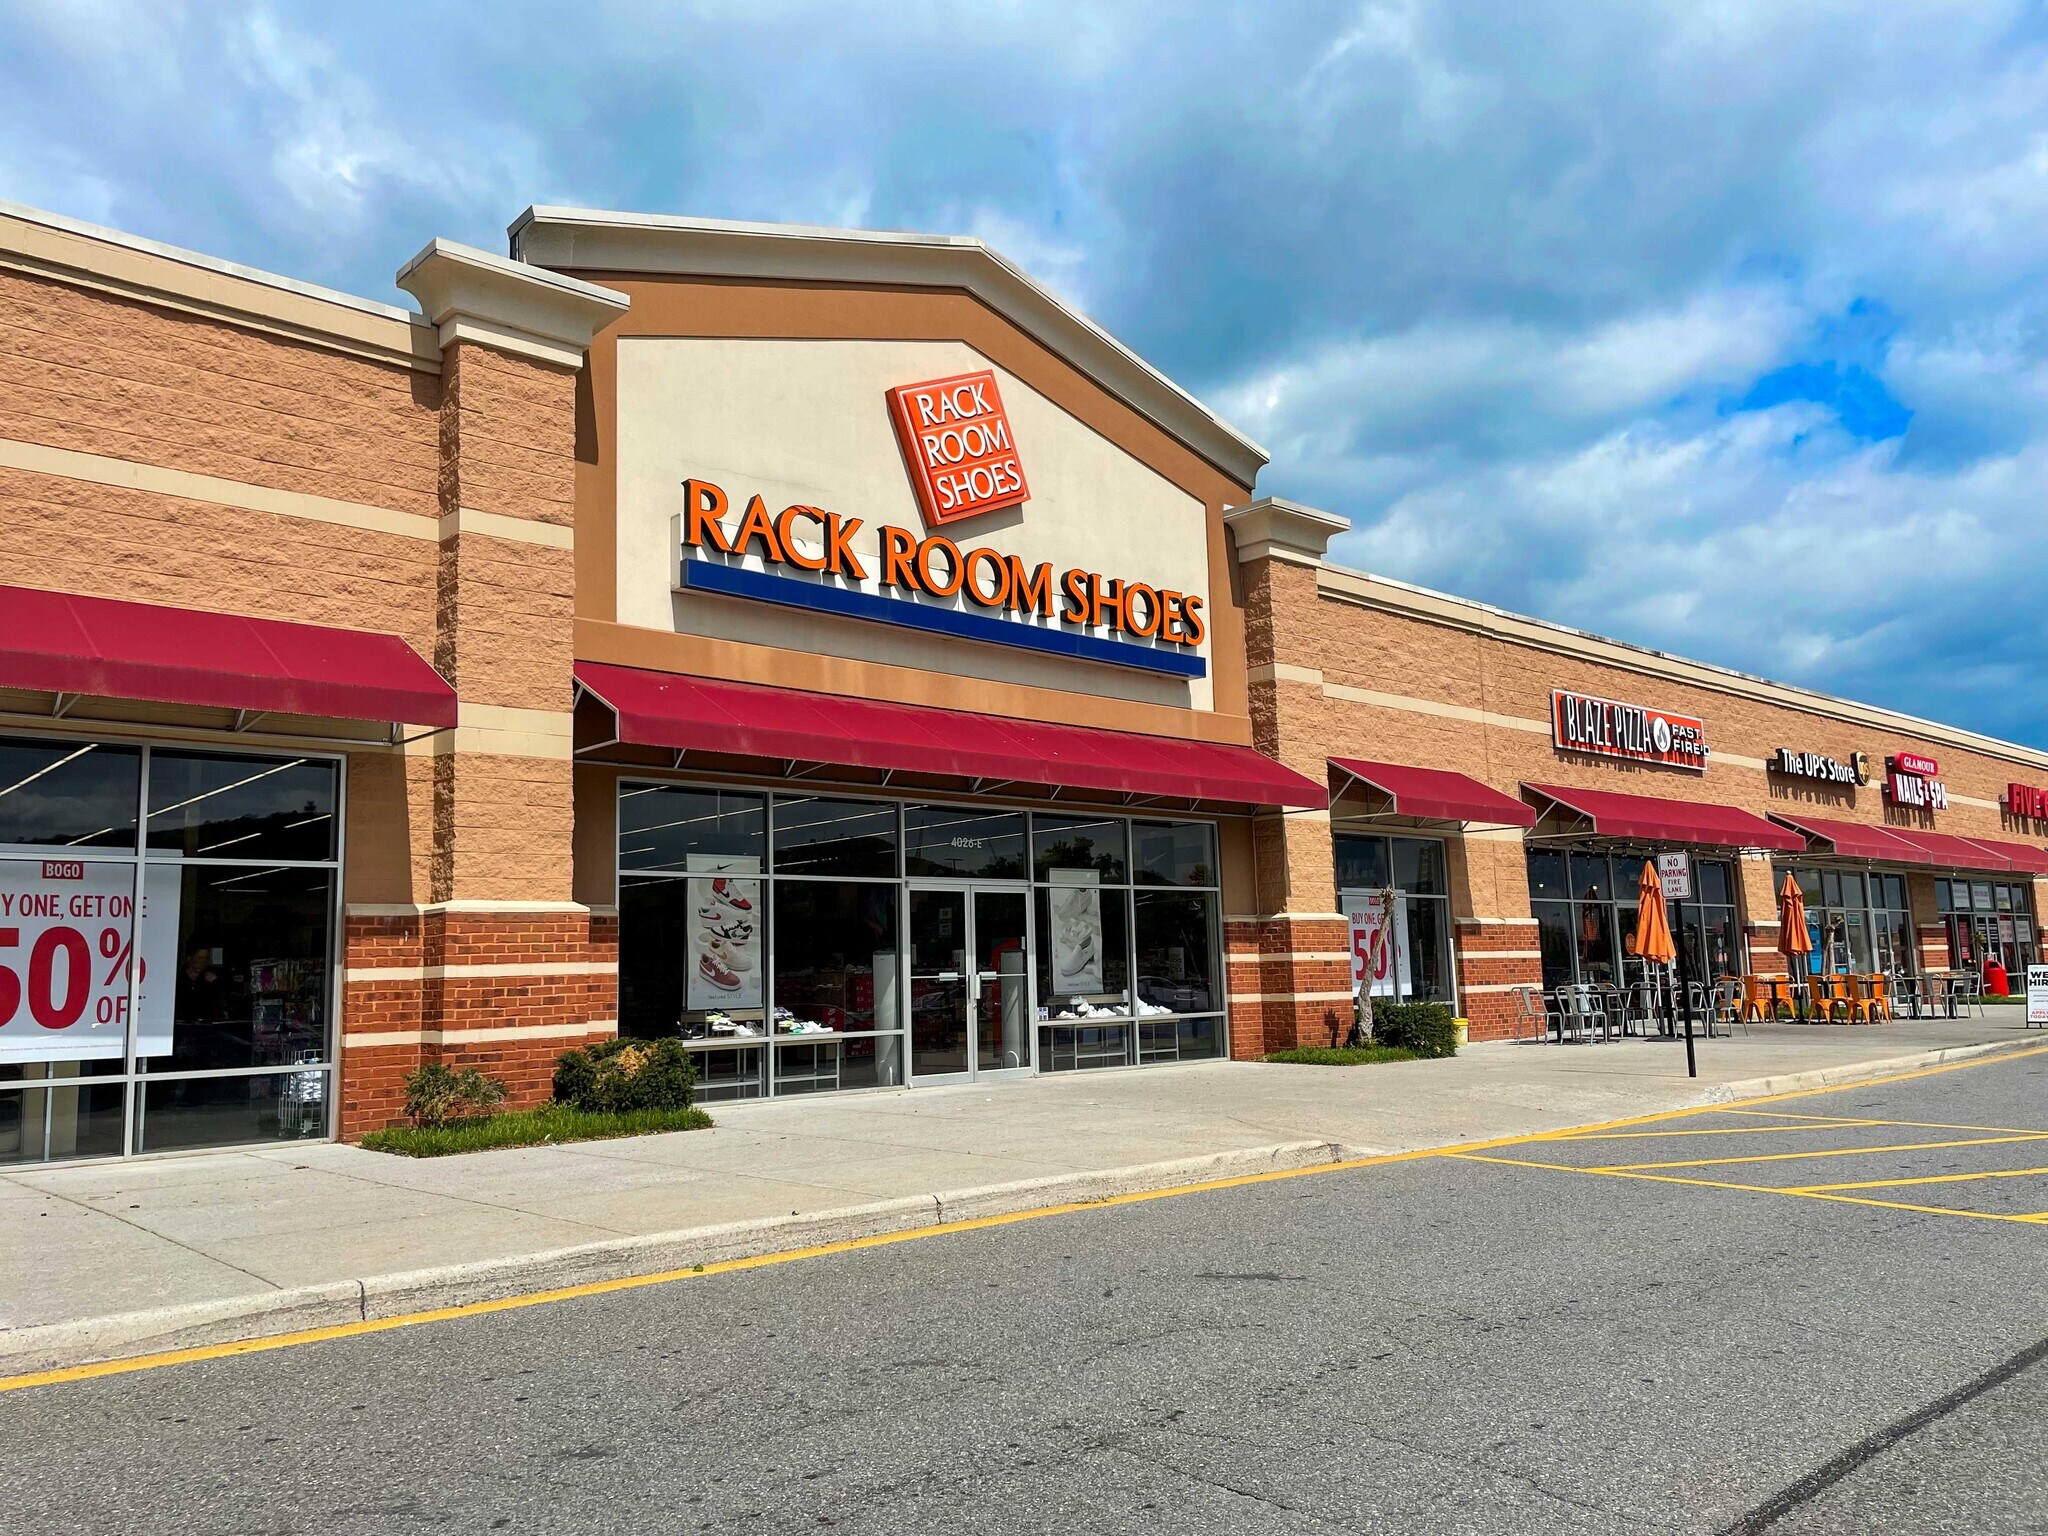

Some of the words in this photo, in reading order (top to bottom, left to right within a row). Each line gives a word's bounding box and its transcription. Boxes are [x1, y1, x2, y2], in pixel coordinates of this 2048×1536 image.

[915, 383, 994, 427] RACK
[922, 420, 1011, 468] ROOM
[936, 460, 1022, 509] SHOES
[683, 478, 869, 580] RACK
[878, 524, 1054, 618] ROOM
[1060, 568, 1206, 646] SHOES
[1566, 694, 1611, 747] BLAZE
[1614, 705, 1653, 753] PIZZA
[1673, 739, 1711, 756] FIRE'D
[1781, 749, 1803, 775] The
[1804, 752, 1827, 780] UPS
[1829, 759, 1856, 784] Store
[1903, 756, 1935, 774] GLAMOUR
[1895, 773, 1925, 806] NAILS
[1929, 780, 1949, 810] SPA
[2013, 783, 2042, 818] FIVE
[951, 836, 982, 849] 4026-E
[46, 863, 80, 878] BOGO
[1661, 868, 1687, 878] PARKING
[1667, 858, 1679, 867] NO
[1667, 878, 1681, 886] FIRE
[19, 893, 65, 920] ONE,
[69, 895, 105, 918] GET
[1352, 912, 1363, 925] BUY
[2030, 971, 2048, 979] WE
